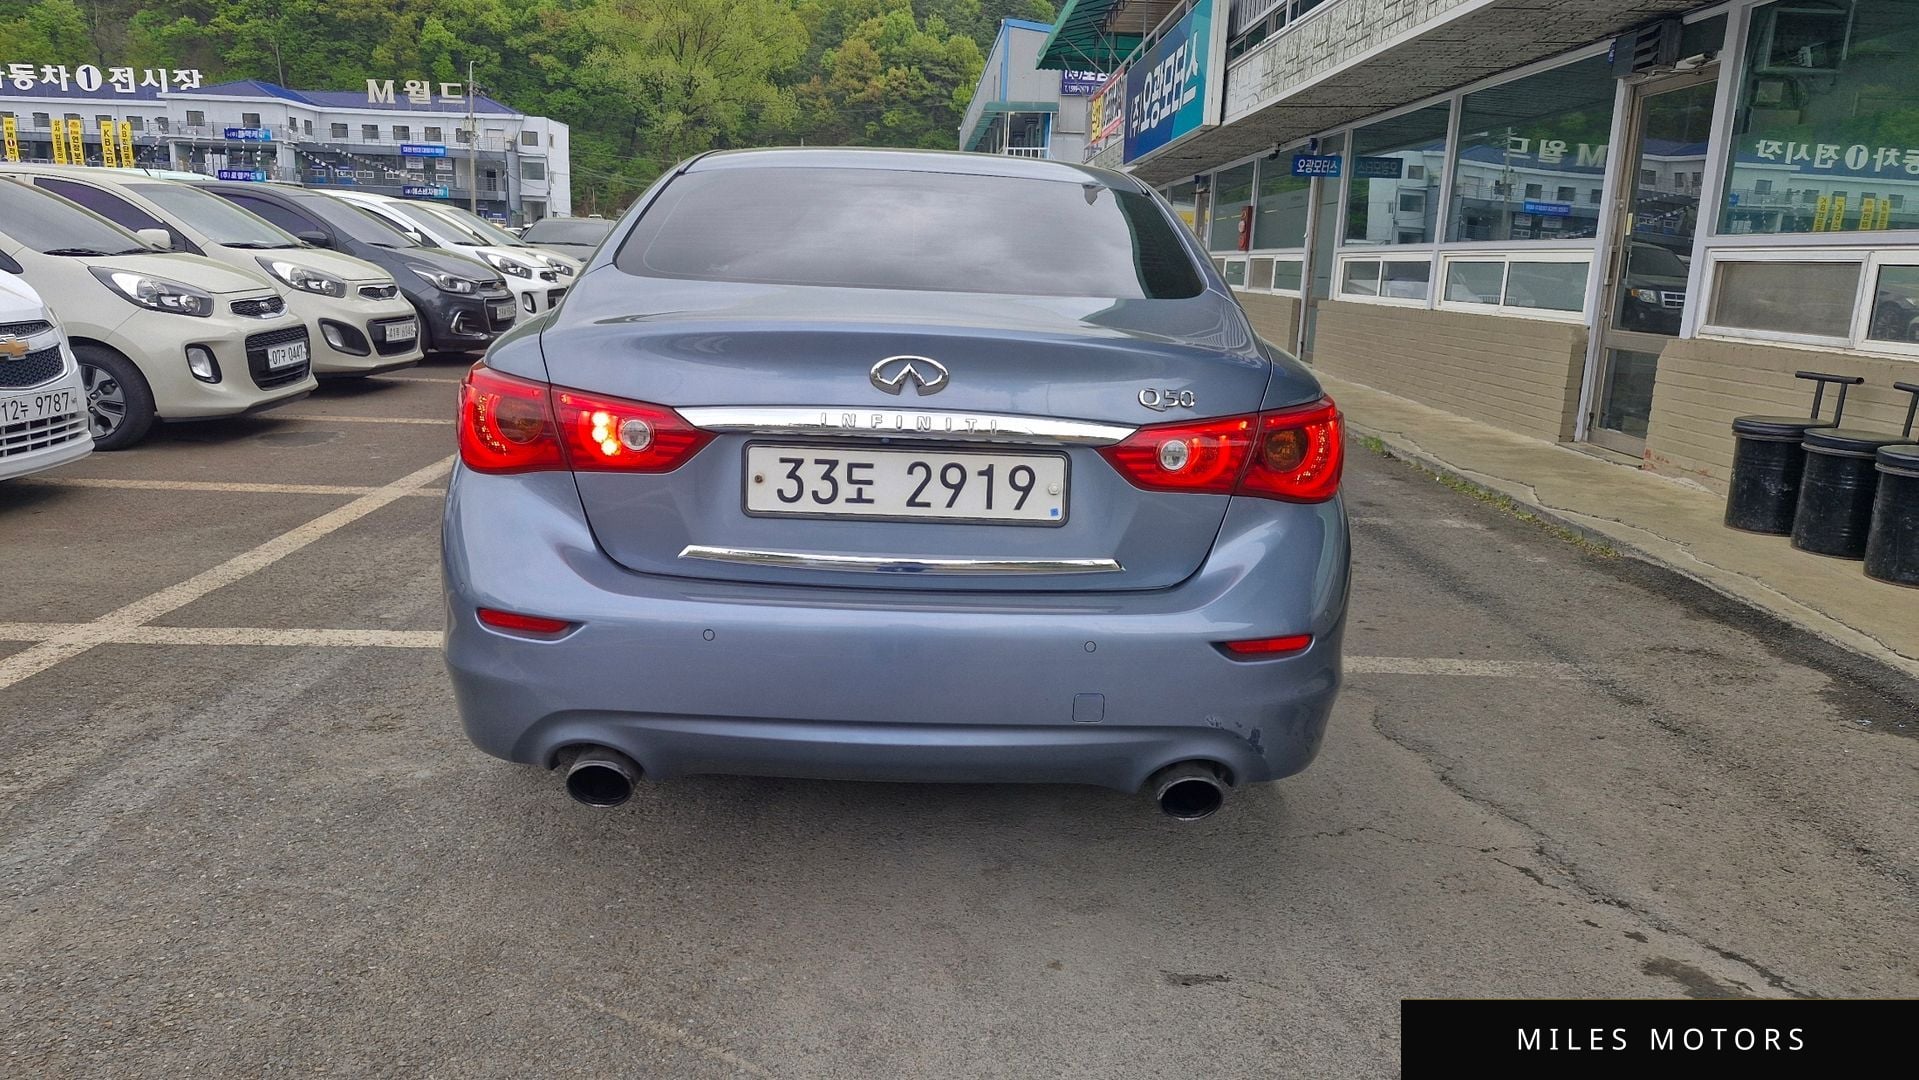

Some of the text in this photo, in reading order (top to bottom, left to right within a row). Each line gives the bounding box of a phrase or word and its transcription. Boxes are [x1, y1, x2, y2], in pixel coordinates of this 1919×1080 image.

[366, 79, 466, 105] M월드
[1296, 159, 1338, 174] 오광모터스
[1, 392, 69, 421] 12누 9787
[1138, 388, 1195, 412] Q50
[820, 412, 998, 435] INFINITI
[776, 457, 1037, 511] 33도 2919
